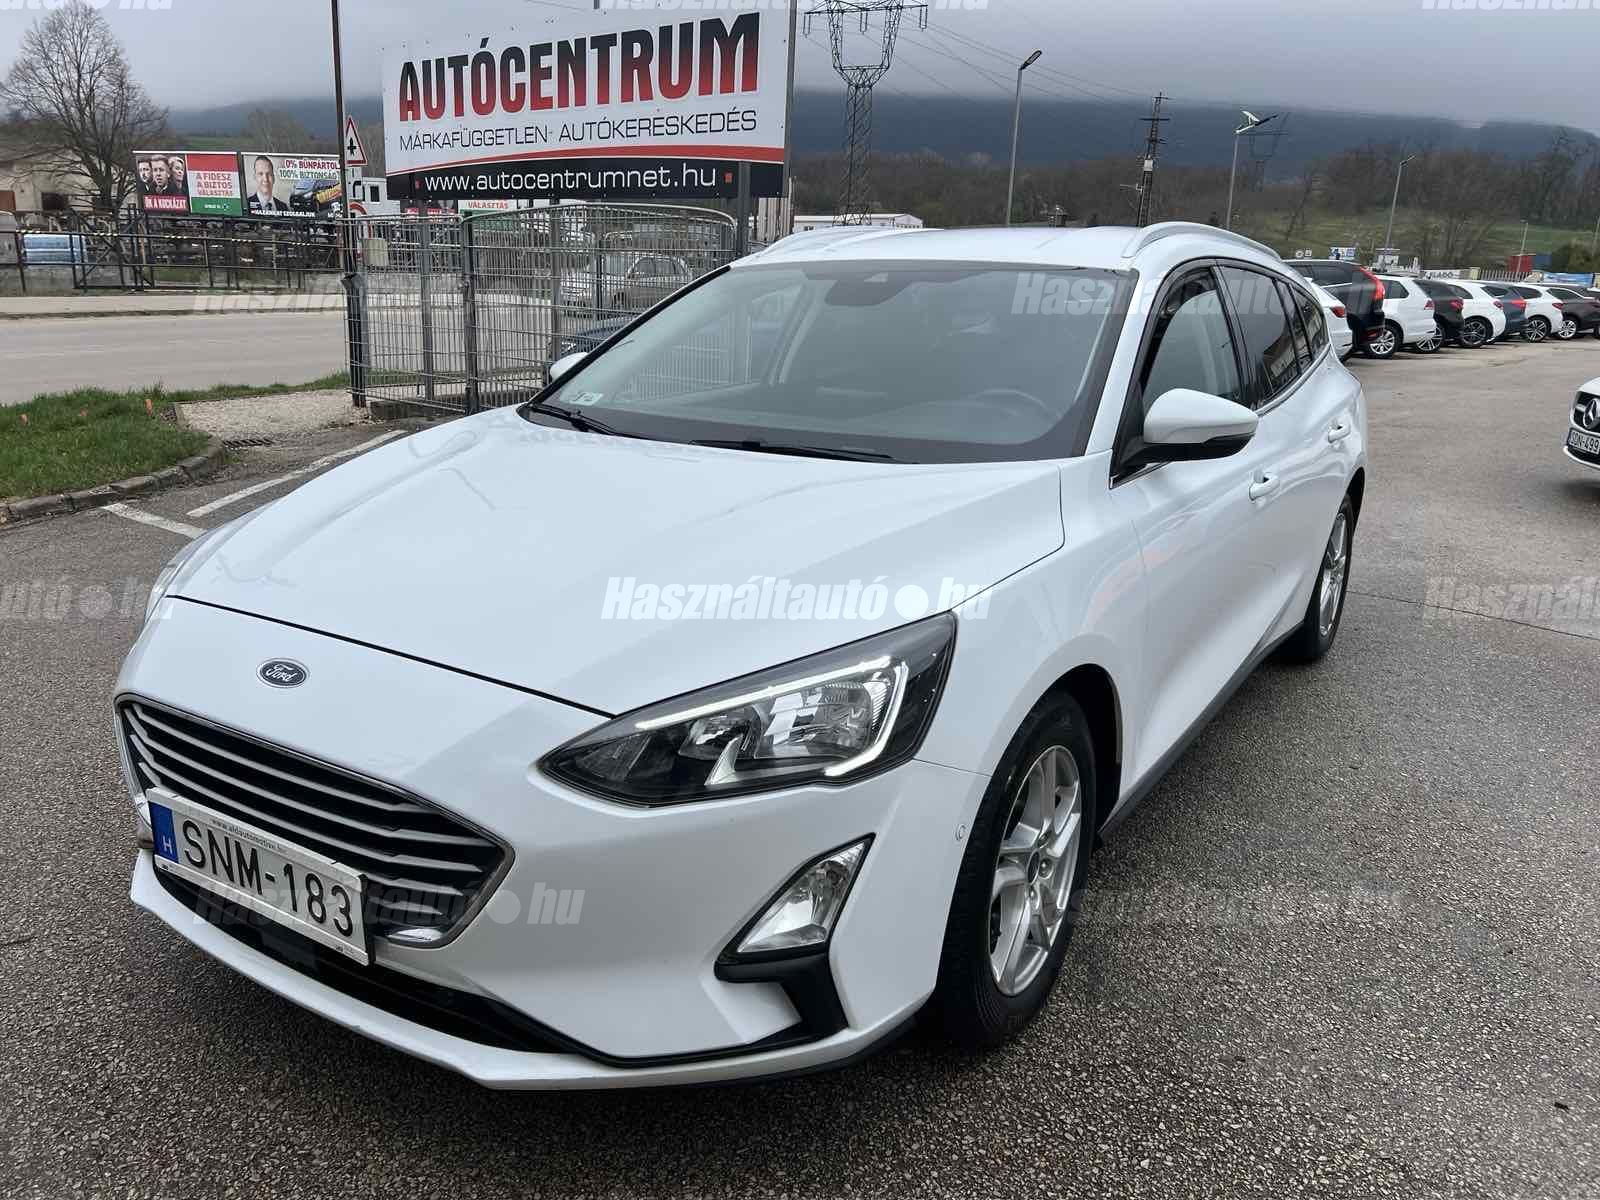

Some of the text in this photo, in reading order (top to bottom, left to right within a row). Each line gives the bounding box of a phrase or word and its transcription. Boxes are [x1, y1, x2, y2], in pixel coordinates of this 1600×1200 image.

[399, 12, 760, 122] AUTÓCENTRUM
[558, 106, 758, 142] AUTÓKERESKEDÉS
[424, 162, 717, 190] www.autocentrumnet.hu
[265, 663, 298, 682] Ford
[162, 835, 173, 854] H
[182, 819, 354, 937] SNM-183
